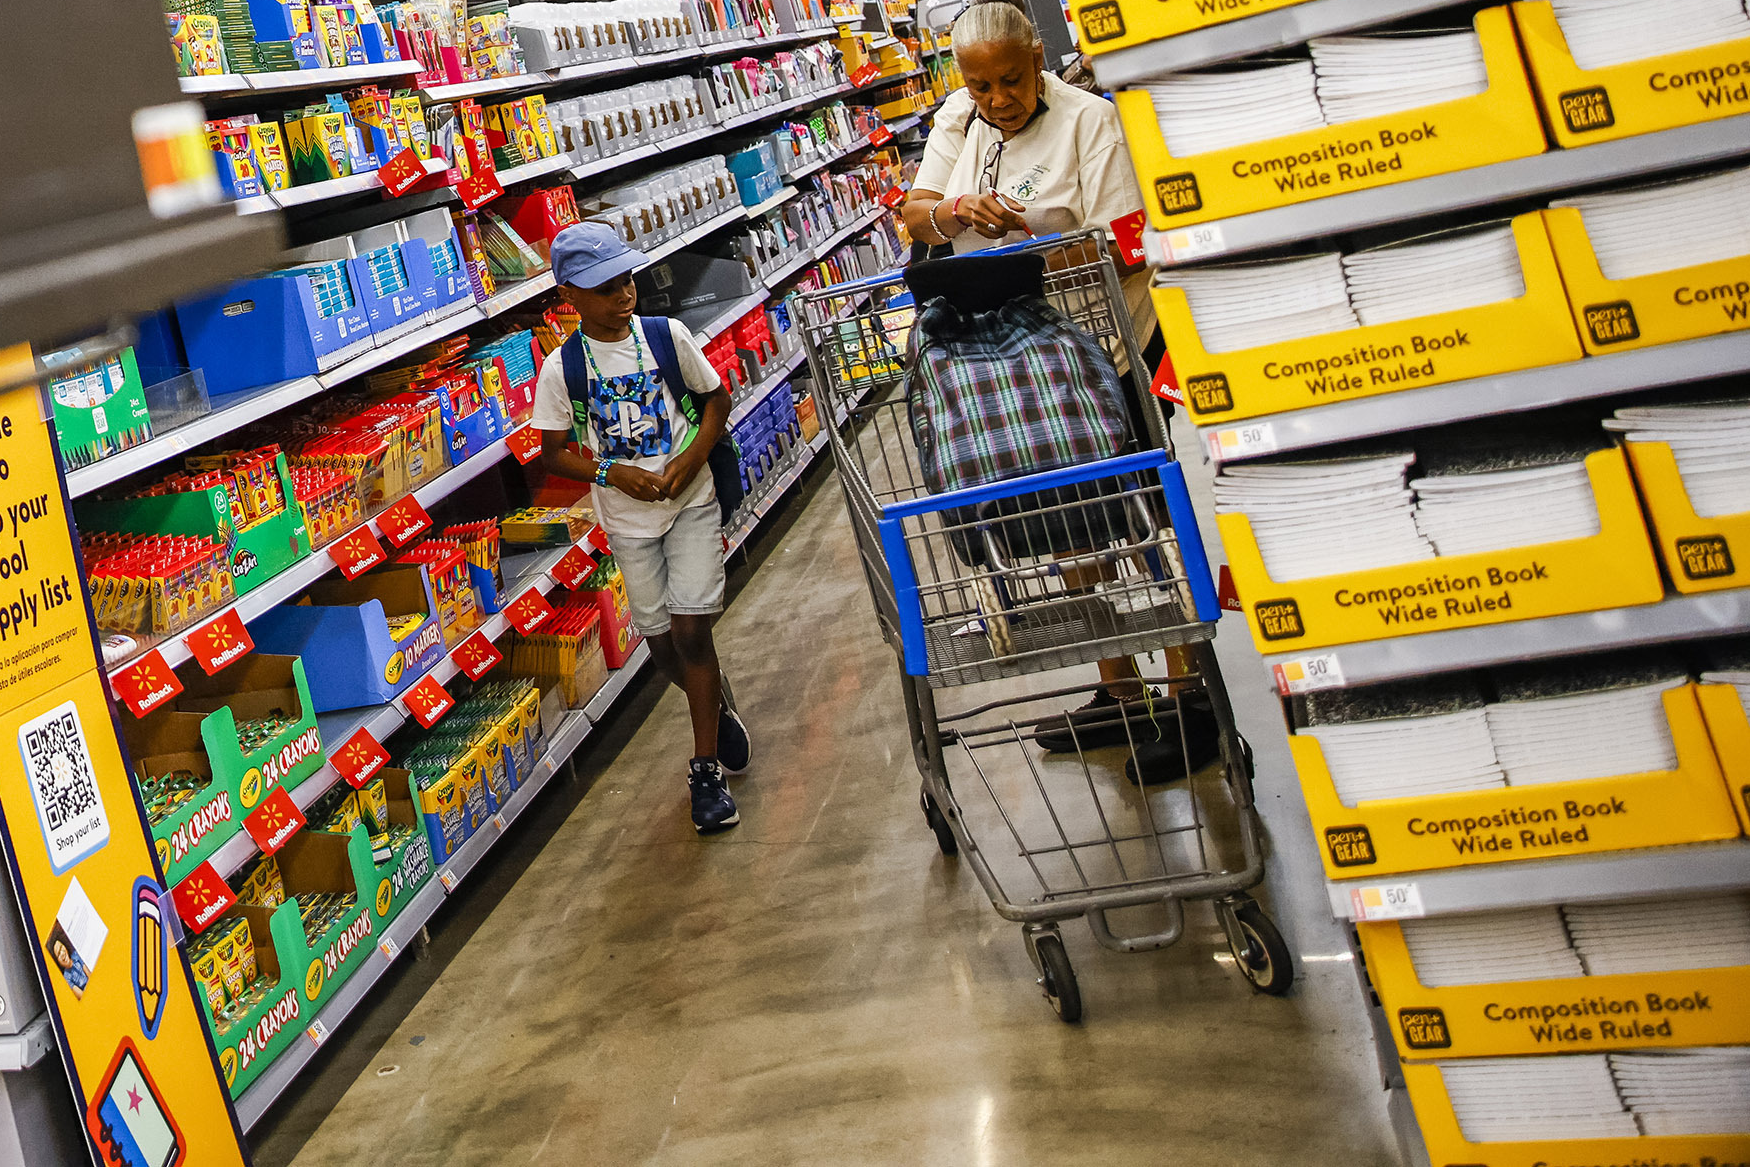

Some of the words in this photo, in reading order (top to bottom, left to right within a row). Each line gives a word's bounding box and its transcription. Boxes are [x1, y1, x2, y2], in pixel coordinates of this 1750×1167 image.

[1649, 60, 1750, 92] Compos
[1232, 140, 1373, 178] Composition
[1379, 122, 1438, 149] Book
[395, 170, 422, 192] Rollback
[1273, 169, 1331, 193] Wide
[1337, 153, 1403, 182] Ruled
[471, 188, 499, 208] Rollback
[1263, 344, 1404, 381] Composition
[1411, 329, 1471, 355] Book
[1304, 374, 1363, 395] Wide
[1369, 359, 1434, 387] Ruled
[522, 445, 542, 460] Rollba
[7, 494, 48, 538] your
[396, 518, 426, 542] Rollback
[348, 552, 379, 575] Rollback
[571, 563, 593, 584] Rollback
[40, 575, 72, 611] list
[1335, 576, 1481, 608] Composition
[1486, 561, 1548, 586] Book
[523, 609, 549, 632] Rollback
[1378, 604, 1438, 626] Wide
[1443, 591, 1512, 617] Ruled
[11, 644, 40, 666] aplicación
[41, 639, 54, 652] para
[55, 627, 78, 645] comprar
[210, 641, 247, 668] Rollback
[412, 621, 442, 661] MARKERS
[10, 674, 17, 685] de
[34, 655, 61, 673] escolares.
[471, 653, 497, 676] Rollback
[137, 684, 174, 711] Rollback
[424, 698, 449, 722] Rollback
[261, 761, 280, 790] 24
[278, 726, 321, 777] CRAYONS
[354, 756, 383, 783] Rollback
[170, 823, 190, 863] 24
[188, 790, 232, 847] CRAYONS
[1407, 808, 1558, 837] Composition
[1563, 796, 1626, 819] Book
[55, 833, 74, 851] Shop
[74, 823, 89, 844] your
[89, 817, 101, 831] list
[266, 817, 299, 849] Rollback
[1452, 834, 1513, 856] Wide
[1521, 824, 1589, 849] Ruled
[194, 895, 229, 927] Rollback
[336, 907, 373, 962] CRAYONS
[1483, 997, 1638, 1023] Composition
[1645, 991, 1712, 1012] Book
[238, 1027, 257, 1071] 24
[256, 987, 300, 1050] CRAYONS
[1529, 1022, 1592, 1043] Wide
[1600, 1018, 1672, 1039] Ruled
